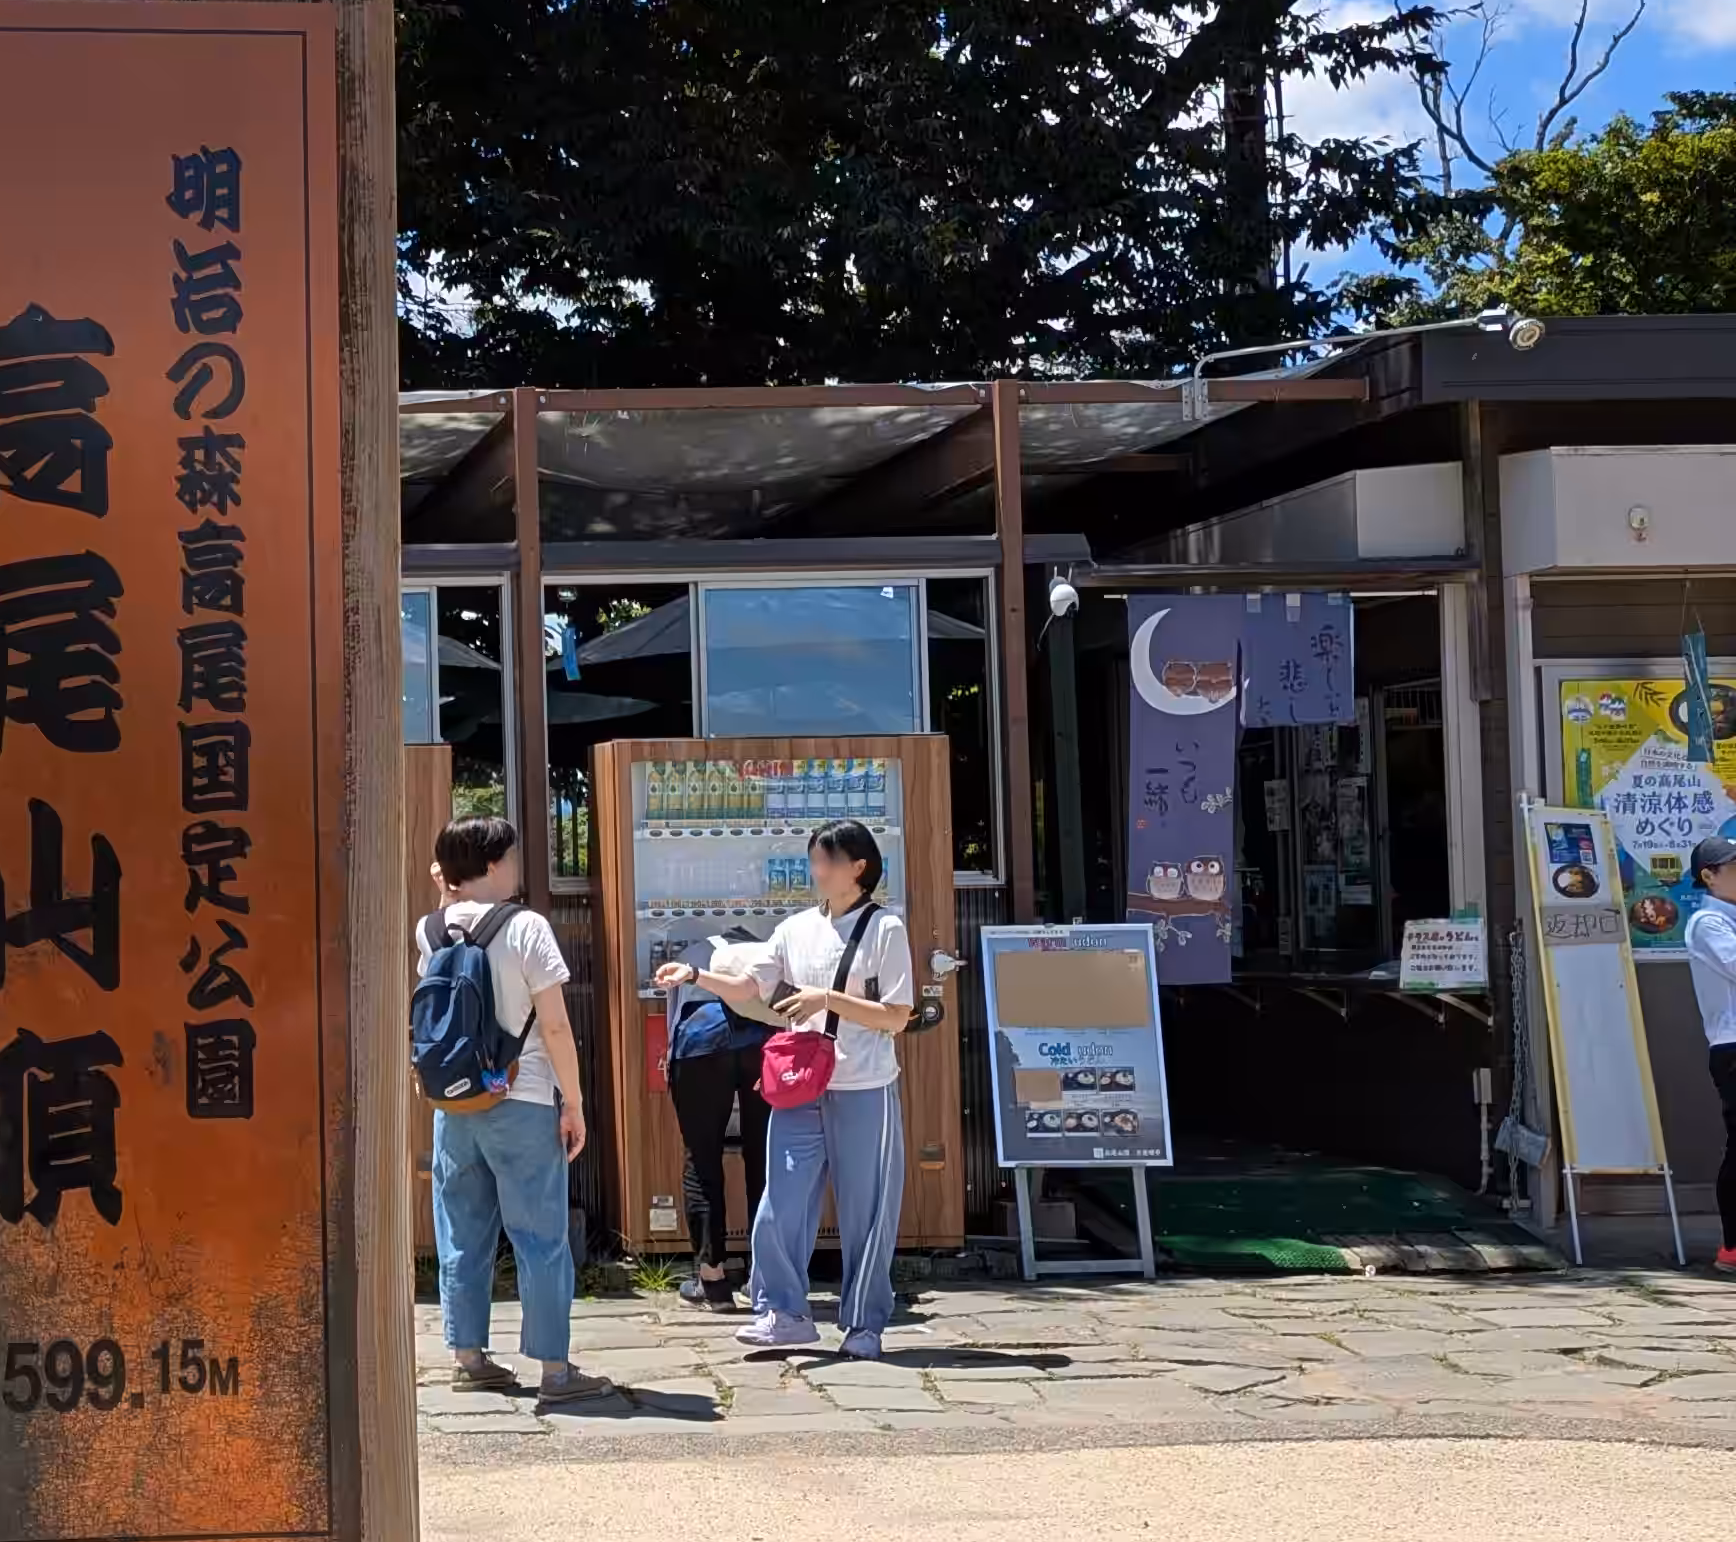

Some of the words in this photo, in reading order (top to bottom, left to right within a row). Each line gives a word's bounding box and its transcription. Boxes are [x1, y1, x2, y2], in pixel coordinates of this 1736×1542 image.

[166, 144, 255, 1119] 明治の森高尾国定公園
[1632, 773, 1701, 789] 夏の高尾山
[1614, 790, 1715, 815] 清涼体感
[1635, 816, 1693, 837] めぐり
[1545, 912, 1619, 938] 返却口
[1038, 1042, 1072, 1057] Cold
